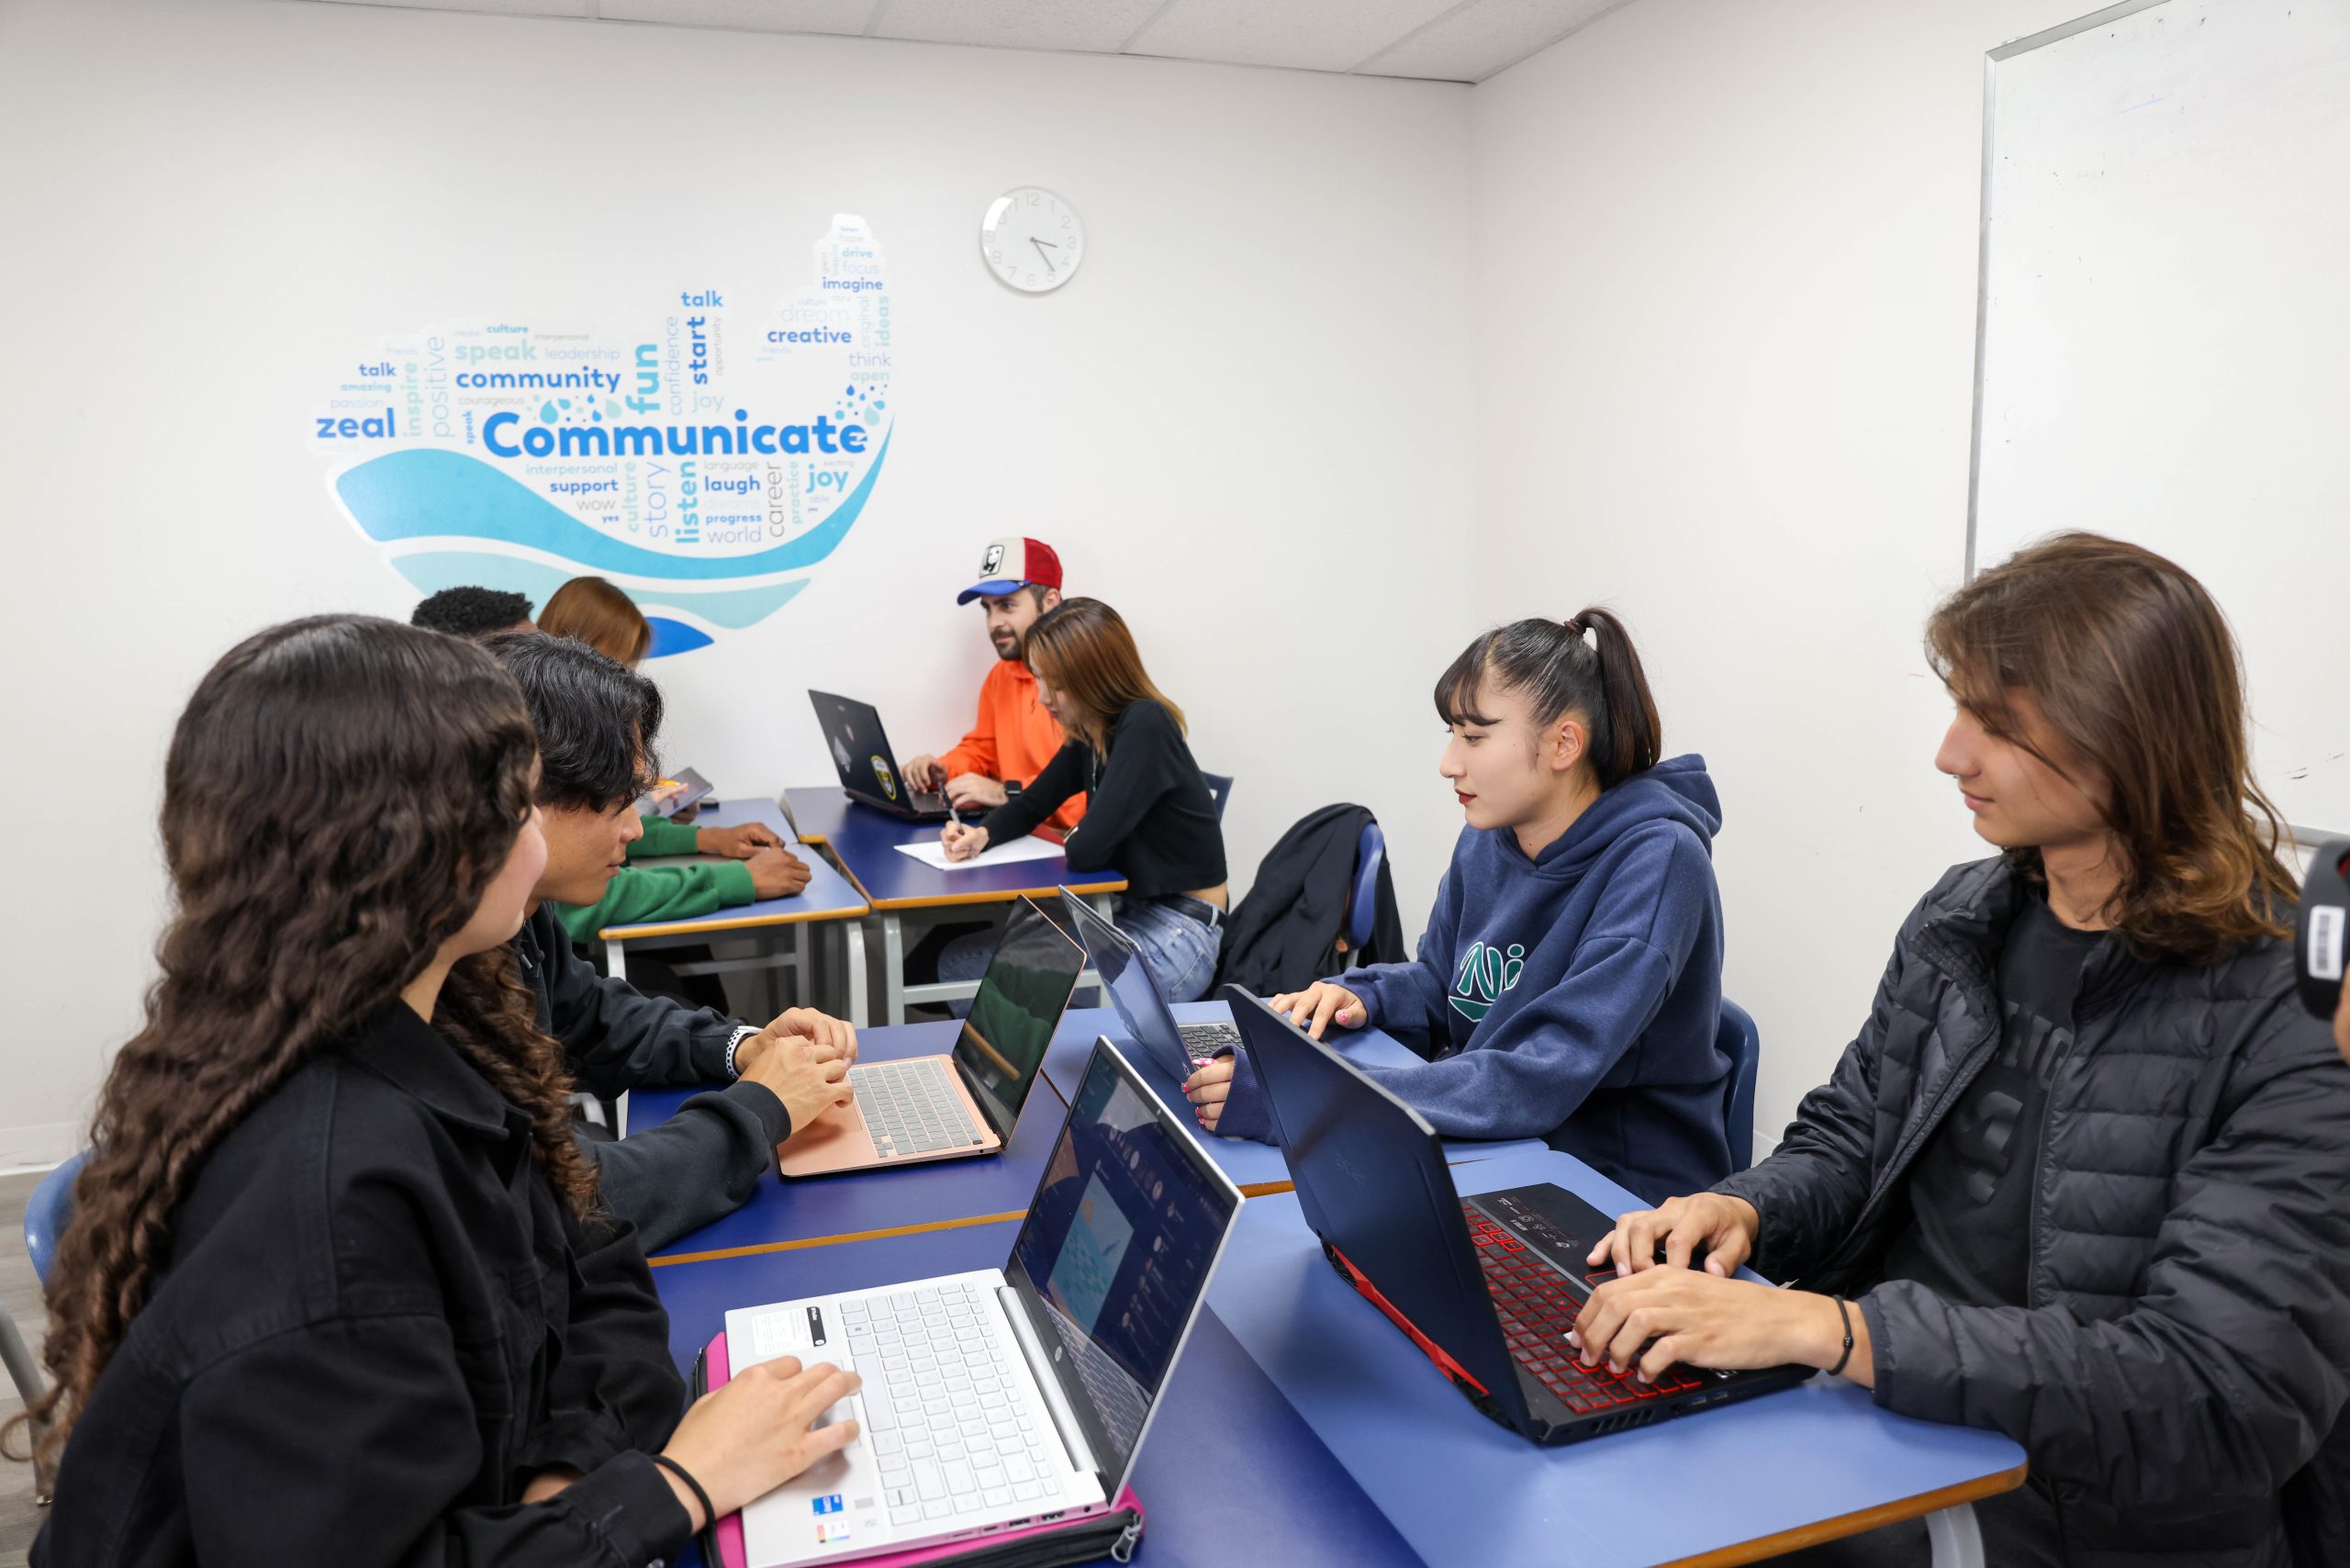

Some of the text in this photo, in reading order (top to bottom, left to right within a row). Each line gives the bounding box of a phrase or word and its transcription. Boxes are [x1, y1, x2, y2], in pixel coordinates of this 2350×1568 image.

[1025, 192, 1040, 207] 12
[1050, 199, 1055, 213] 1
[1060, 215, 1071, 229] 2
[1067, 235, 1077, 249] 3
[842, 246, 873, 258] drive
[991, 250, 1002, 264] 8
[843, 261, 880, 274] focus
[1061, 256, 1070, 270] 4
[1007, 265, 1017, 280] 7
[1026, 274, 1035, 287] 6
[1046, 267, 1057, 283] 5
[822, 276, 883, 292] imagine
[680, 290, 723, 308] talk
[780, 304, 850, 322] dream
[875, 296, 891, 347] ideas
[487, 324, 529, 334] culture
[767, 326, 852, 343] creative
[454, 339, 537, 366] speak
[544, 346, 621, 364] leadership
[686, 316, 709, 386] start
[849, 352, 891, 367] think
[358, 362, 397, 377] talk
[664, 316, 682, 416] confidence
[455, 364, 621, 394] community
[621, 343, 661, 415] fun
[851, 371, 890, 386] open
[341, 382, 392, 394] amazing
[425, 337, 455, 438] positive
[330, 398, 384, 409] passion
[401, 362, 424, 437] inspire
[458, 395, 525, 407] courageous
[691, 390, 725, 413] joy
[316, 407, 396, 439] zeal
[464, 410, 476, 445] speak
[482, 409, 868, 458] Communicate
[526, 463, 618, 476] interpersonal
[703, 460, 759, 473] language
[550, 478, 620, 496] support
[704, 475, 761, 495] laugh
[805, 464, 849, 494] joy
[621, 462, 640, 532] culture
[643, 461, 672, 538] story
[766, 461, 785, 538] career
[787, 460, 804, 525] practice
[576, 499, 616, 511] wow
[675, 461, 700, 543] listen
[602, 515, 620, 524] yes
[705, 514, 763, 526] progress
[707, 526, 762, 543] world
